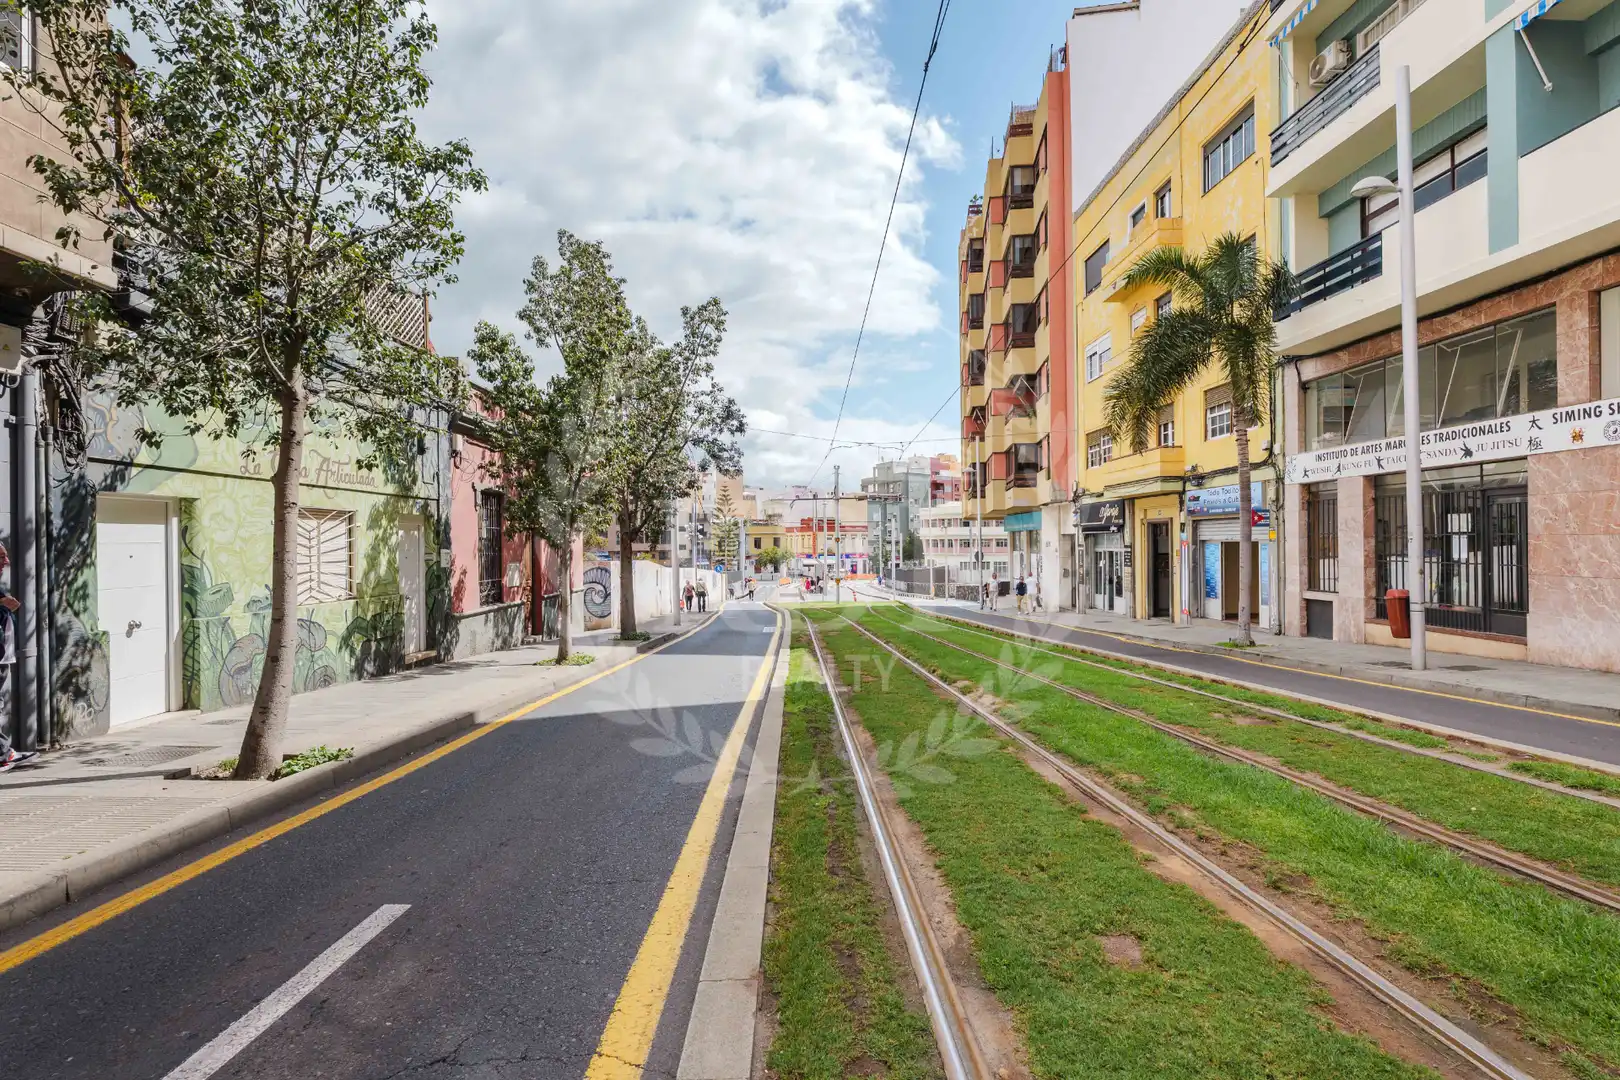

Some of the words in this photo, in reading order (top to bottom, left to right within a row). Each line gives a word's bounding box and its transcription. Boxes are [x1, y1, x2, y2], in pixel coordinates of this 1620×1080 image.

[1552, 405, 1603, 424] SIMING
[1310, 465, 1332, 475] WUSHU
[1342, 461, 1363, 471] KUNG
[1364, 459, 1373, 468] FU
[1427, 447, 1458, 459] SANDA
[1475, 442, 1488, 453] JU
[1490, 437, 1523, 450] JITSU
[1315, 450, 1348, 462] INSTITUTO
[1350, 447, 1359, 457] DE
[1361, 443, 1383, 455] ARTES
[1385, 435, 1431, 451] MARES
[1434, 420, 1511, 444] TRADICIONALES
[240, 457, 262, 475] La
[268, 450, 309, 478] Ca
[309, 450, 378, 498] Articulada
